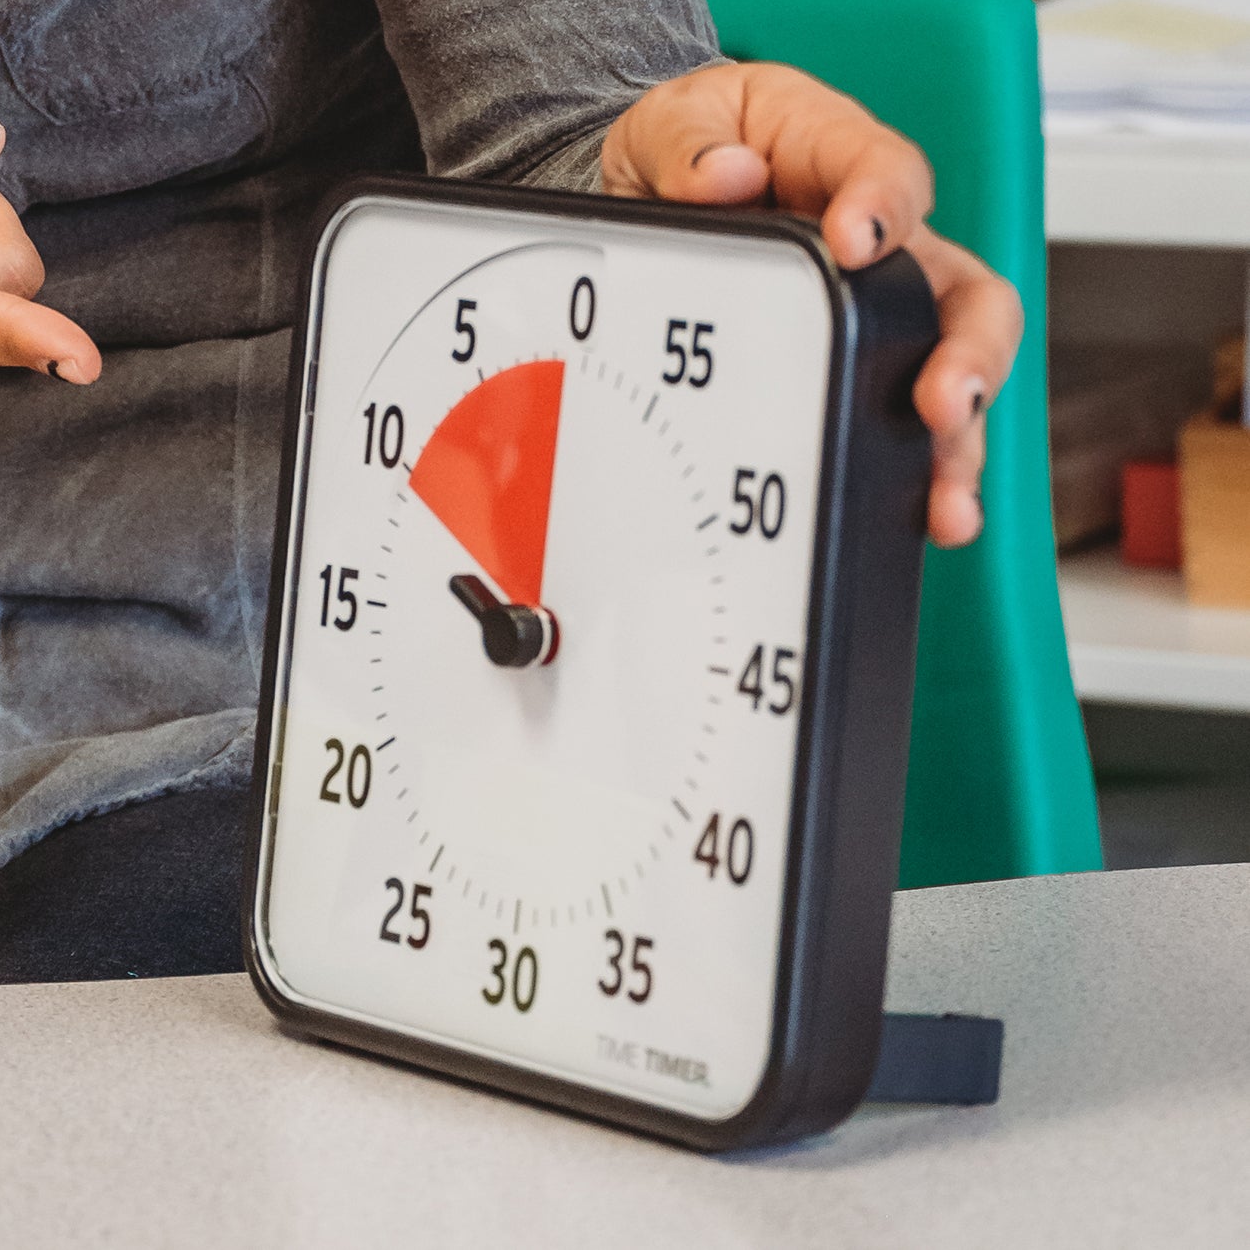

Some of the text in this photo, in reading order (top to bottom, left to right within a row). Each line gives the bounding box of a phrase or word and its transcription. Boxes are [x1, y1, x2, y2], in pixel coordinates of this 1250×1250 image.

[451, 298, 478, 364] 5
[569, 276, 596, 341] 0
[662, 319, 714, 389] 55
[363, 402, 404, 469] 10
[729, 468, 786, 540] 50
[319, 564, 359, 632] 15
[737, 644, 796, 716] 45
[319, 738, 372, 809] 20
[694, 813, 754, 887] 40
[379, 877, 433, 950] 25
[482, 938, 538, 1013] 30
[598, 929, 654, 1004] 35
